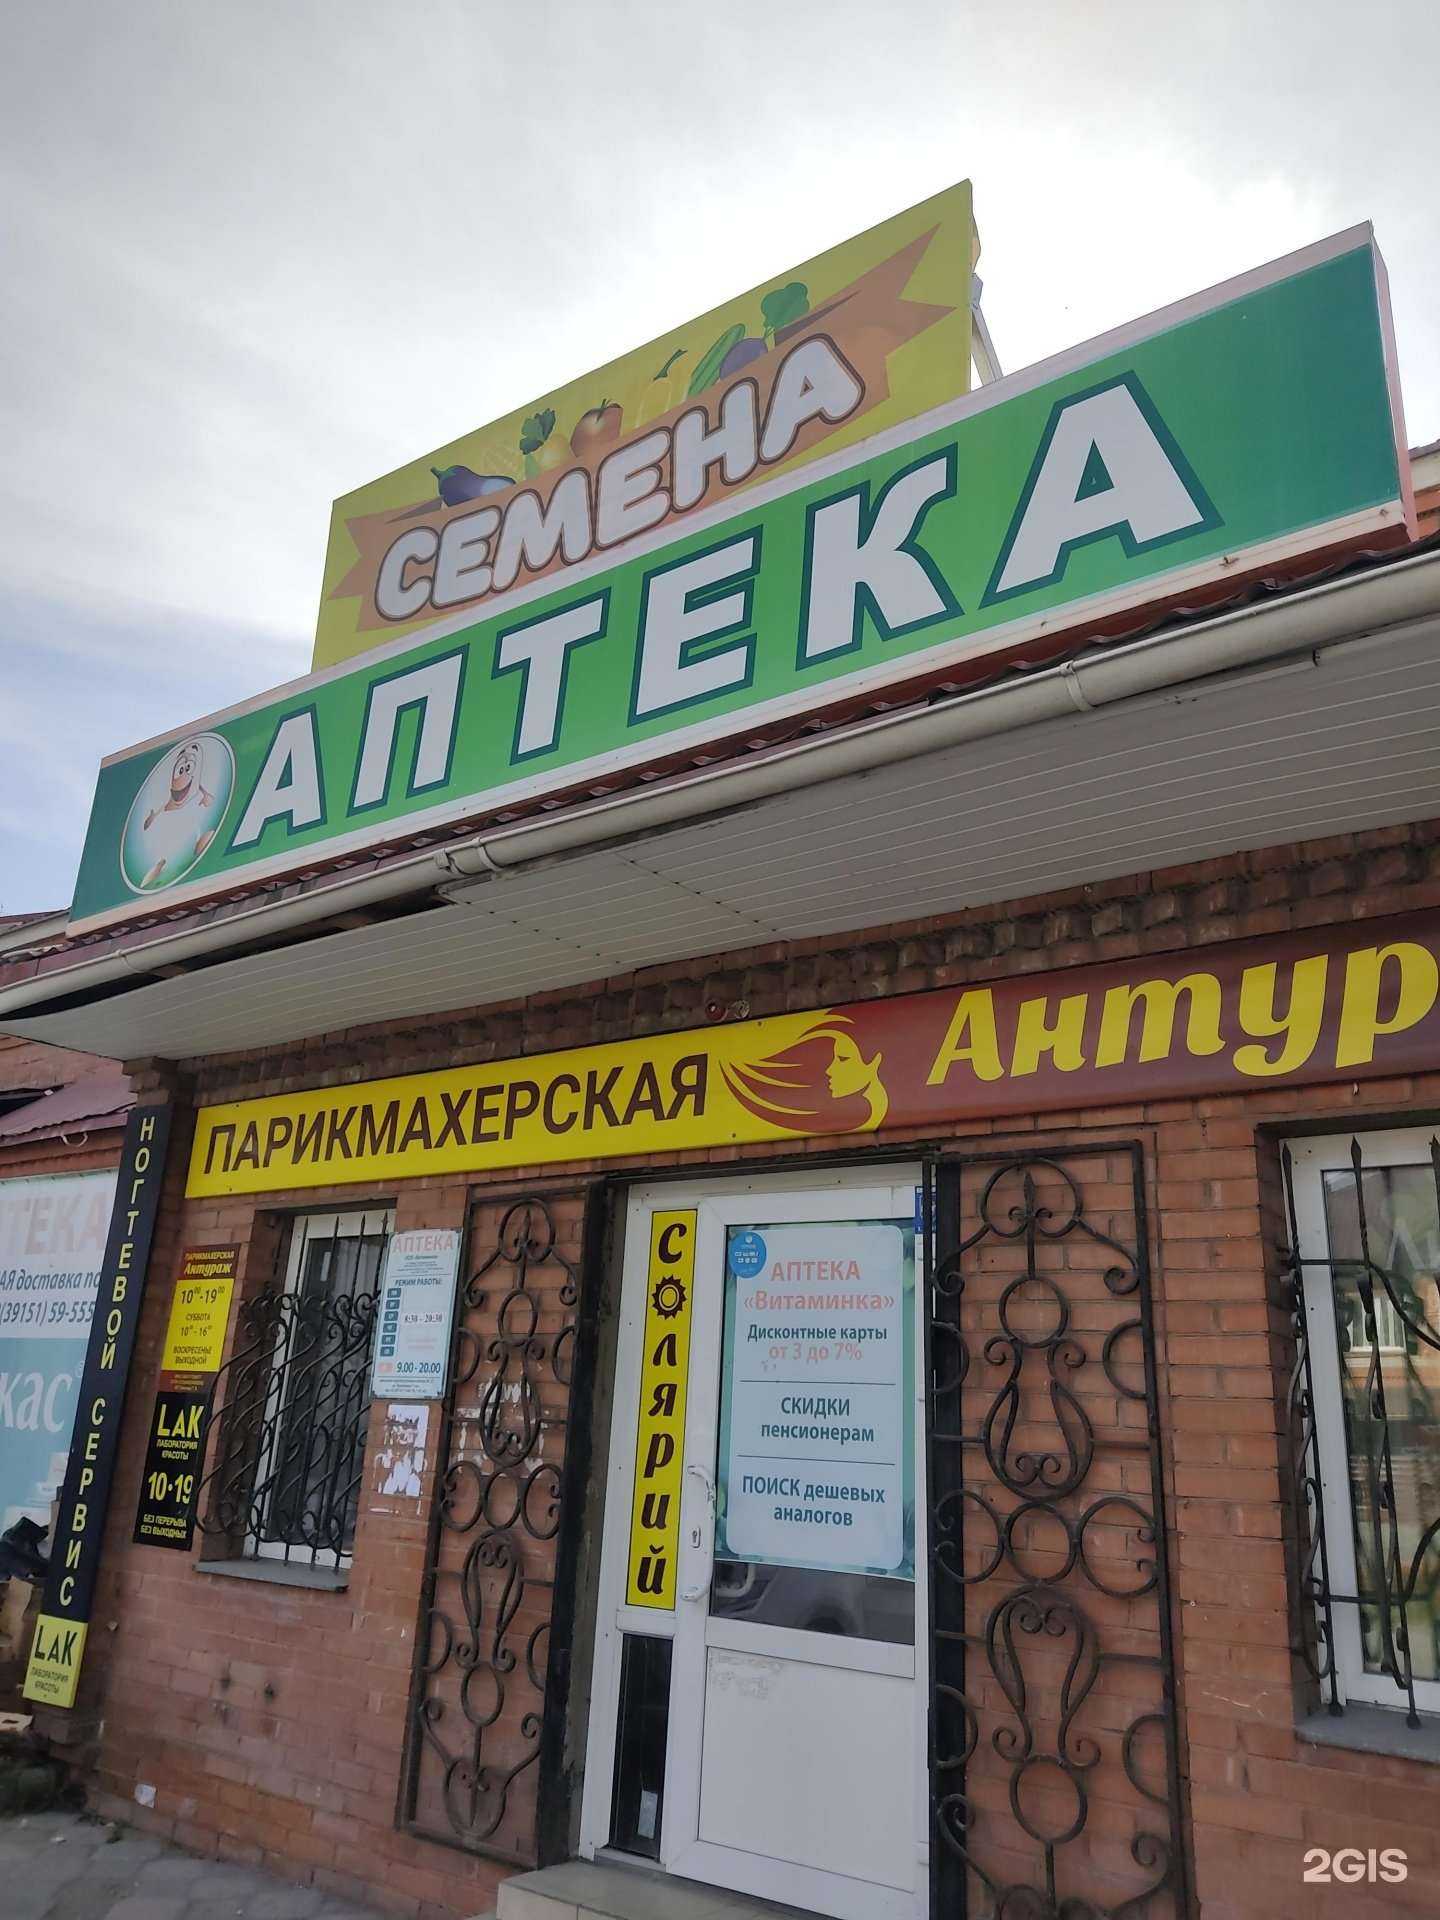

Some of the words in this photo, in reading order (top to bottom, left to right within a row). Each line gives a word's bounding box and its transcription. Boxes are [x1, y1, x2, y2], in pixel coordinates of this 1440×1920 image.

[377, 334, 866, 622] СЕМЕНА
[226, 372, 1222, 853] АПТЕКА
[204, 1054, 708, 1175] ПАРИКМАХЕРСКАЯ
[926, 942, 1439, 1086] Антур
[101, 1116, 155, 1370] НОГТЕВОЙ
[393, 1234, 454, 1254] АПТЕКА
[17, 1269, 82, 1290] доставка
[184, 1263, 232, 1277] Антураж
[771, 1261, 861, 1281] АПТЕКА
[395, 1279, 416, 1287] РЕЖИМ
[744, 1290, 895, 1311] «Витаминка»
[0, 1301, 47, 1326] (39151)
[748, 1324, 837, 1342] Дисконтные
[840, 1326, 888, 1343] карты
[768, 1346, 787, 1360] от
[792, 1343, 801, 1360] 3
[806, 1346, 830, 1363] до
[834, 1343, 863, 1360] 7%
[780, 1397, 851, 1417] СКИДКИ
[761, 1422, 875, 1444] пенсионерам
[156, 1439, 198, 1450] ЛАБОРАТОРИЯ
[161, 1450, 190, 1461] КРАСОТЫ
[742, 1475, 800, 1497] ПОИСК
[803, 1482, 886, 1503] дешевых
[60, 1398, 106, 1606] СЕРВИС
[773, 1505, 853, 1527] аналогов
